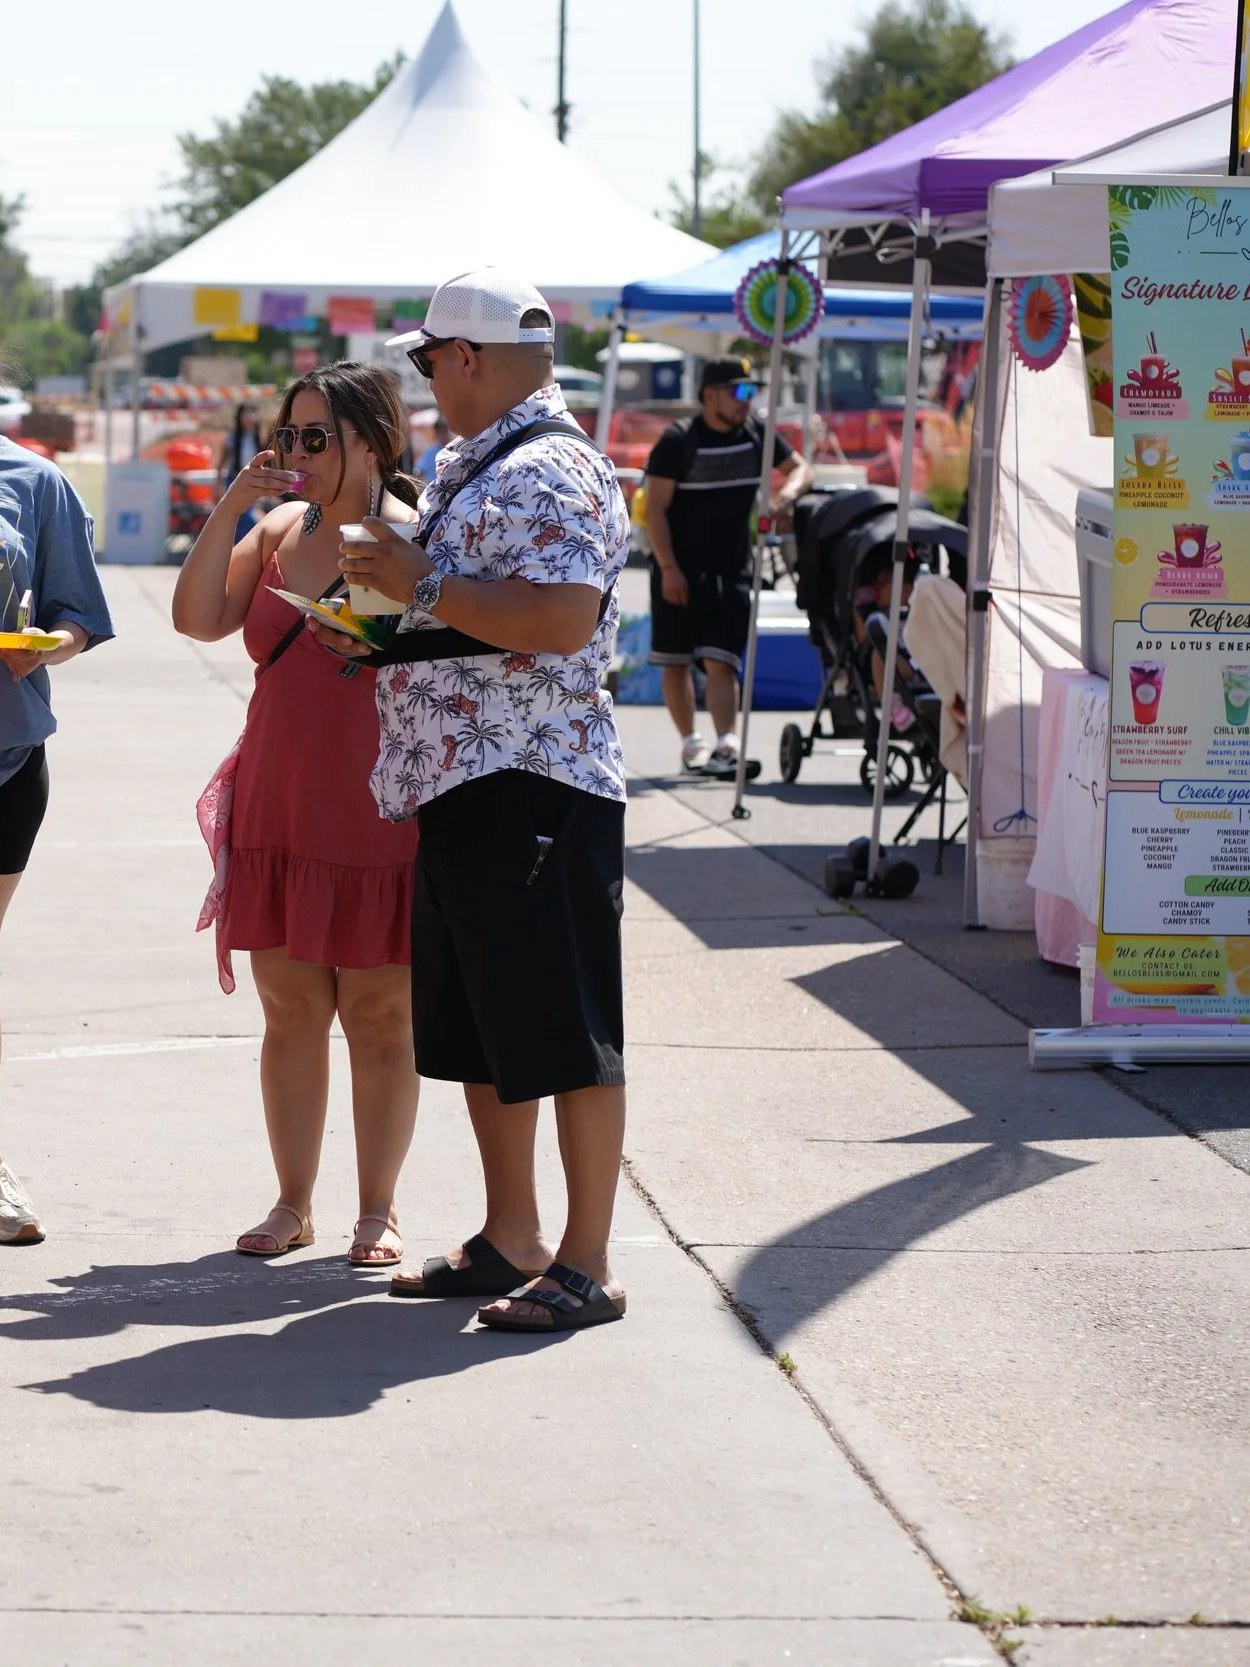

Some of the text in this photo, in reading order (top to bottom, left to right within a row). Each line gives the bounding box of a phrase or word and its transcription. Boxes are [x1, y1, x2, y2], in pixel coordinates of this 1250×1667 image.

[1186, 197, 1248, 239] Bellos
[1121, 276, 1240, 306] Signature
[1124, 388, 1177, 397] CHAMOYADA
[1119, 491, 1153, 499] PINEAPPLE
[1136, 641, 1162, 650] ADD
[1170, 641, 1212, 651] LOTUS
[1112, 725, 1188, 735] STRAWBERRY SURF
[1213, 726, 1234, 735] CHILL
[1178, 784, 1226, 799] Create
[1174, 808, 1234, 821] Lemonade
[1204, 879, 1235, 892] Add
[1116, 947, 1222, 959] We Also Cater
[1141, 962, 1179, 970] CONTACT
